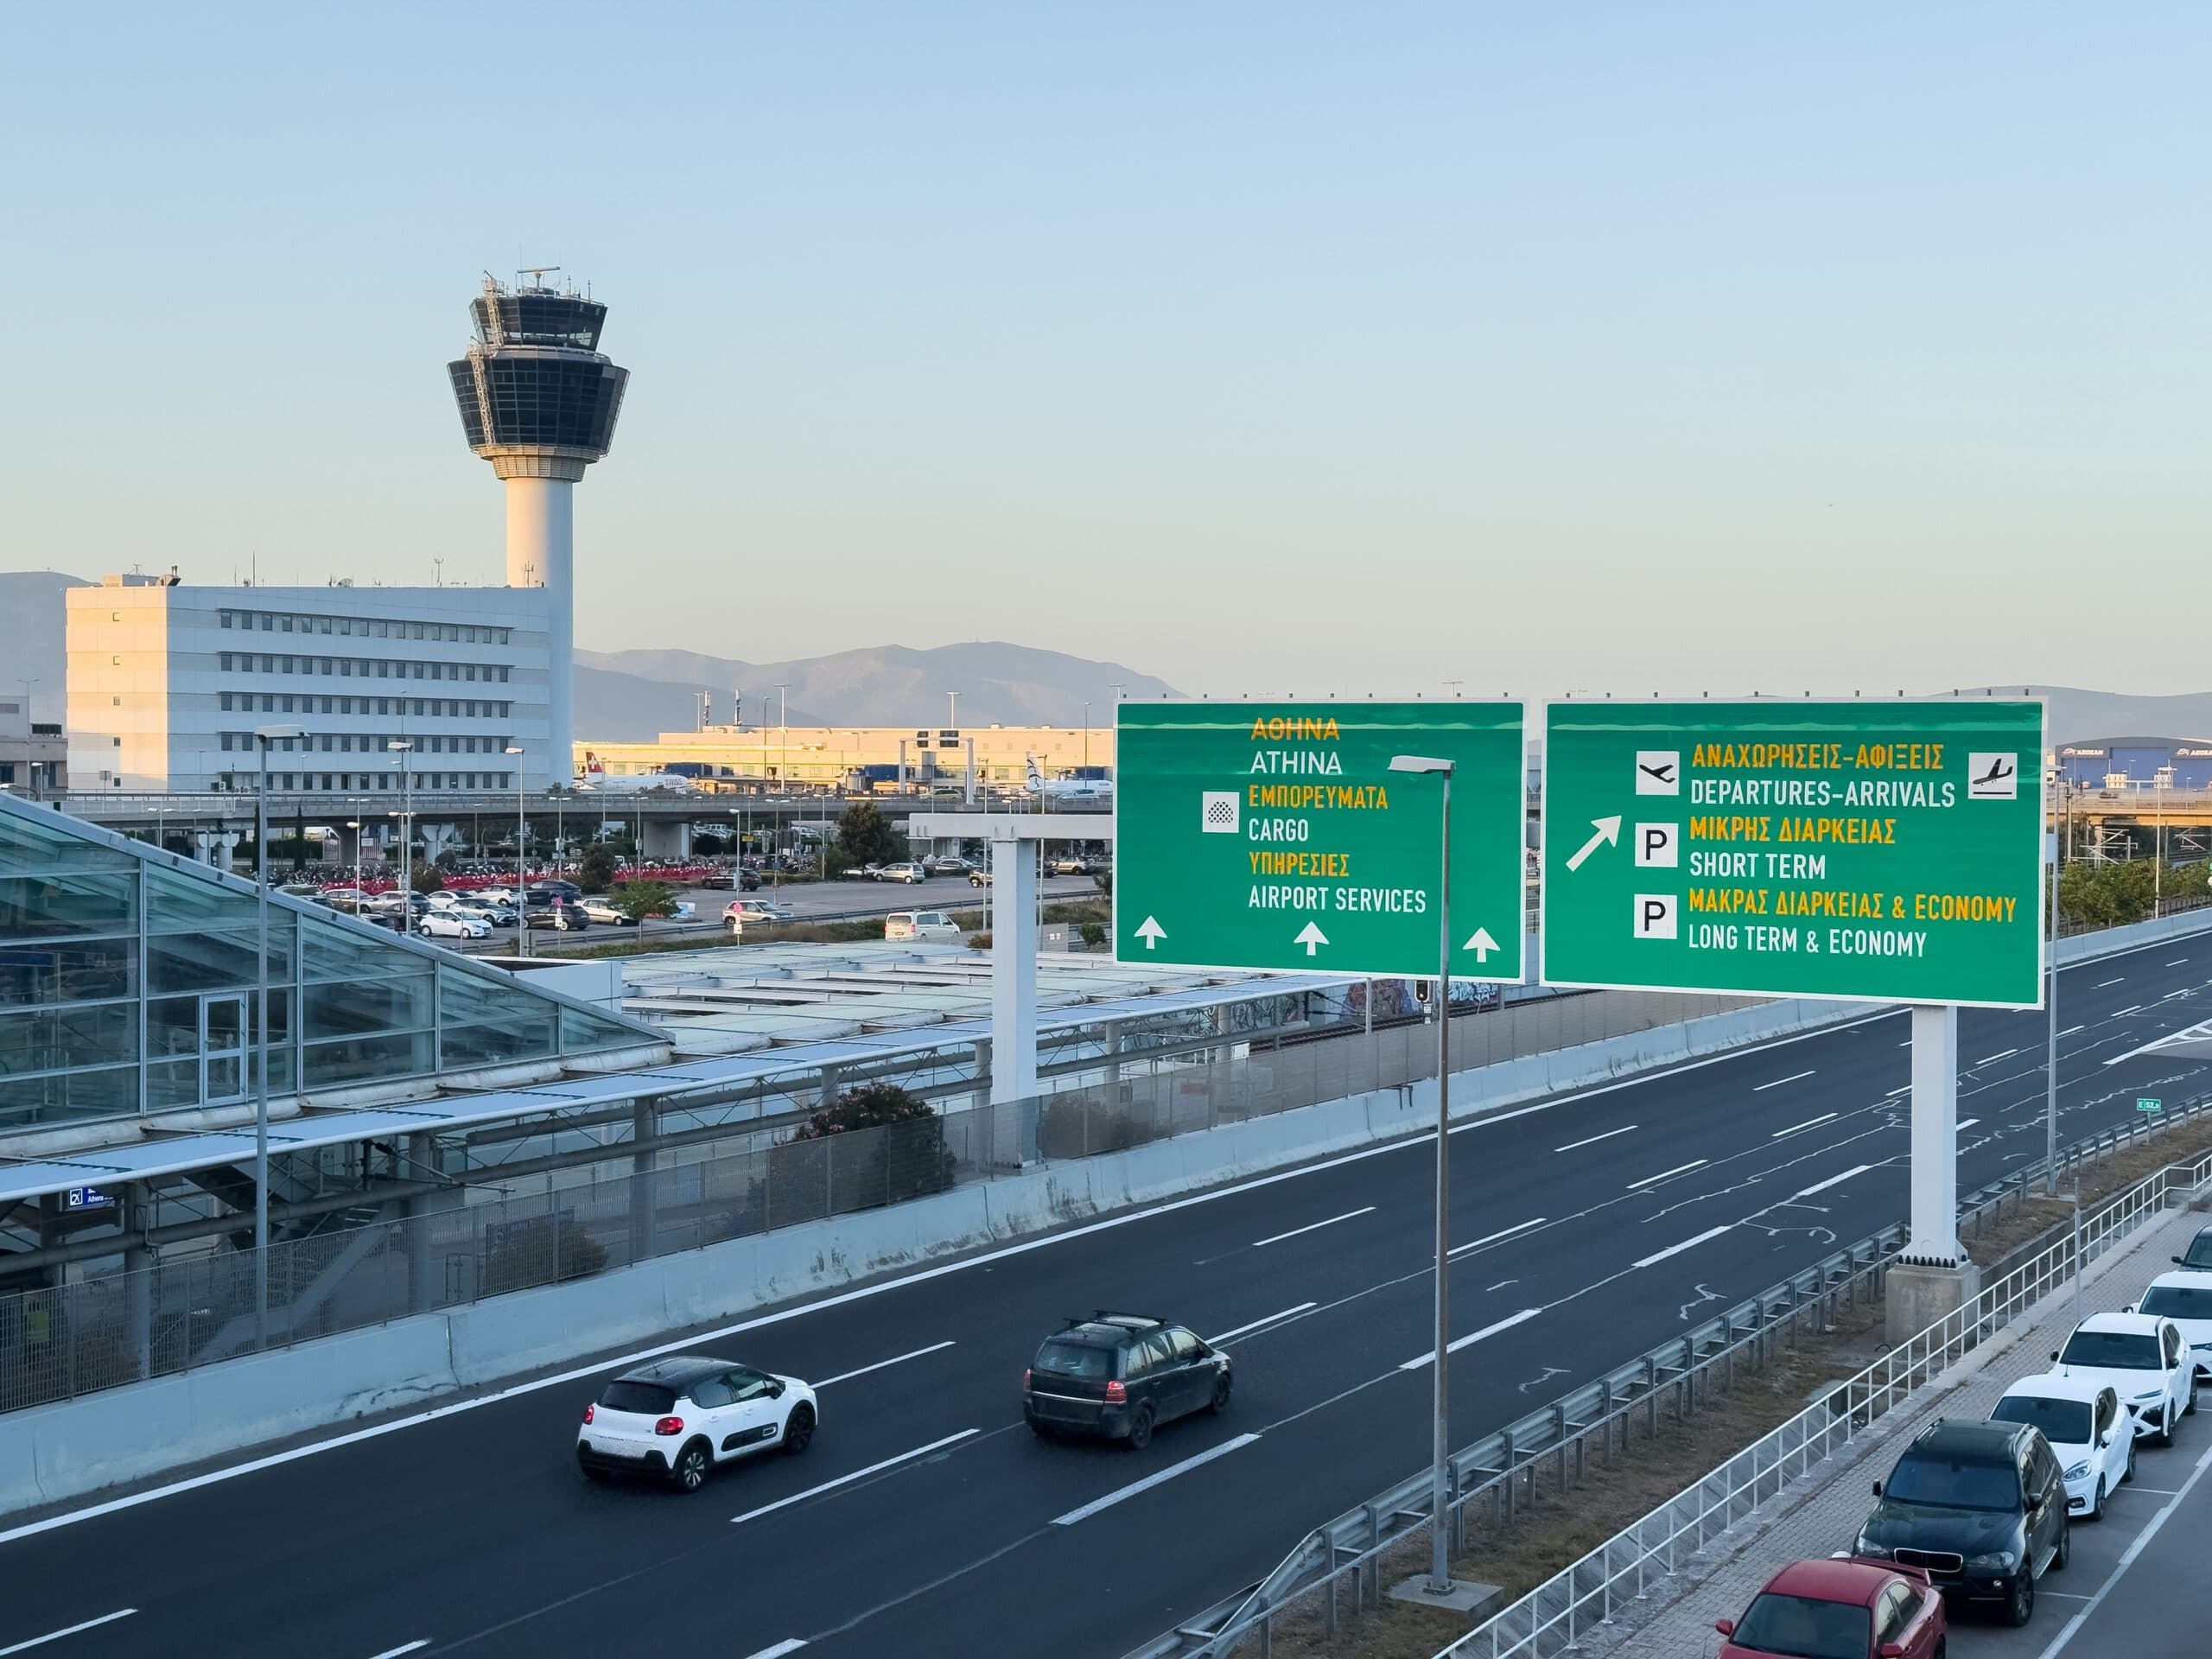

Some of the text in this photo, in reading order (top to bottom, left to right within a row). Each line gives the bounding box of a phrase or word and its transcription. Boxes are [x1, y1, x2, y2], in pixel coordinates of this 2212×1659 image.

[1251, 718, 1340, 741] ΑΘΗΝΑ
[1250, 752, 1343, 774] ATHINA
[1249, 785, 1388, 810] ΕΜΠΟΡΕΥΜΑΤΑ
[1692, 780, 1955, 807] DEPARTURES-ARRIVALS
[1249, 819, 1308, 842] CARGO
[1690, 817, 1896, 843] ΜΙΚΡΗΣ ΔΙΑΡΚΕΙΑΣ
[1646, 830, 1667, 860] P
[1249, 852, 1350, 876] ΥΠΗΡΕΣΙΕΣ
[1690, 852, 1826, 879] SHORT TERM
[1249, 886, 1426, 913] AIRPORT SERVICES
[1689, 888, 2016, 922] ΜΑΚΡΑΣ ΔΙΑΡΚΕΙΑΣ & ECONOMY
[1645, 901, 1666, 931] P
[1689, 925, 1926, 957] LONG TERM & ECONOMY
